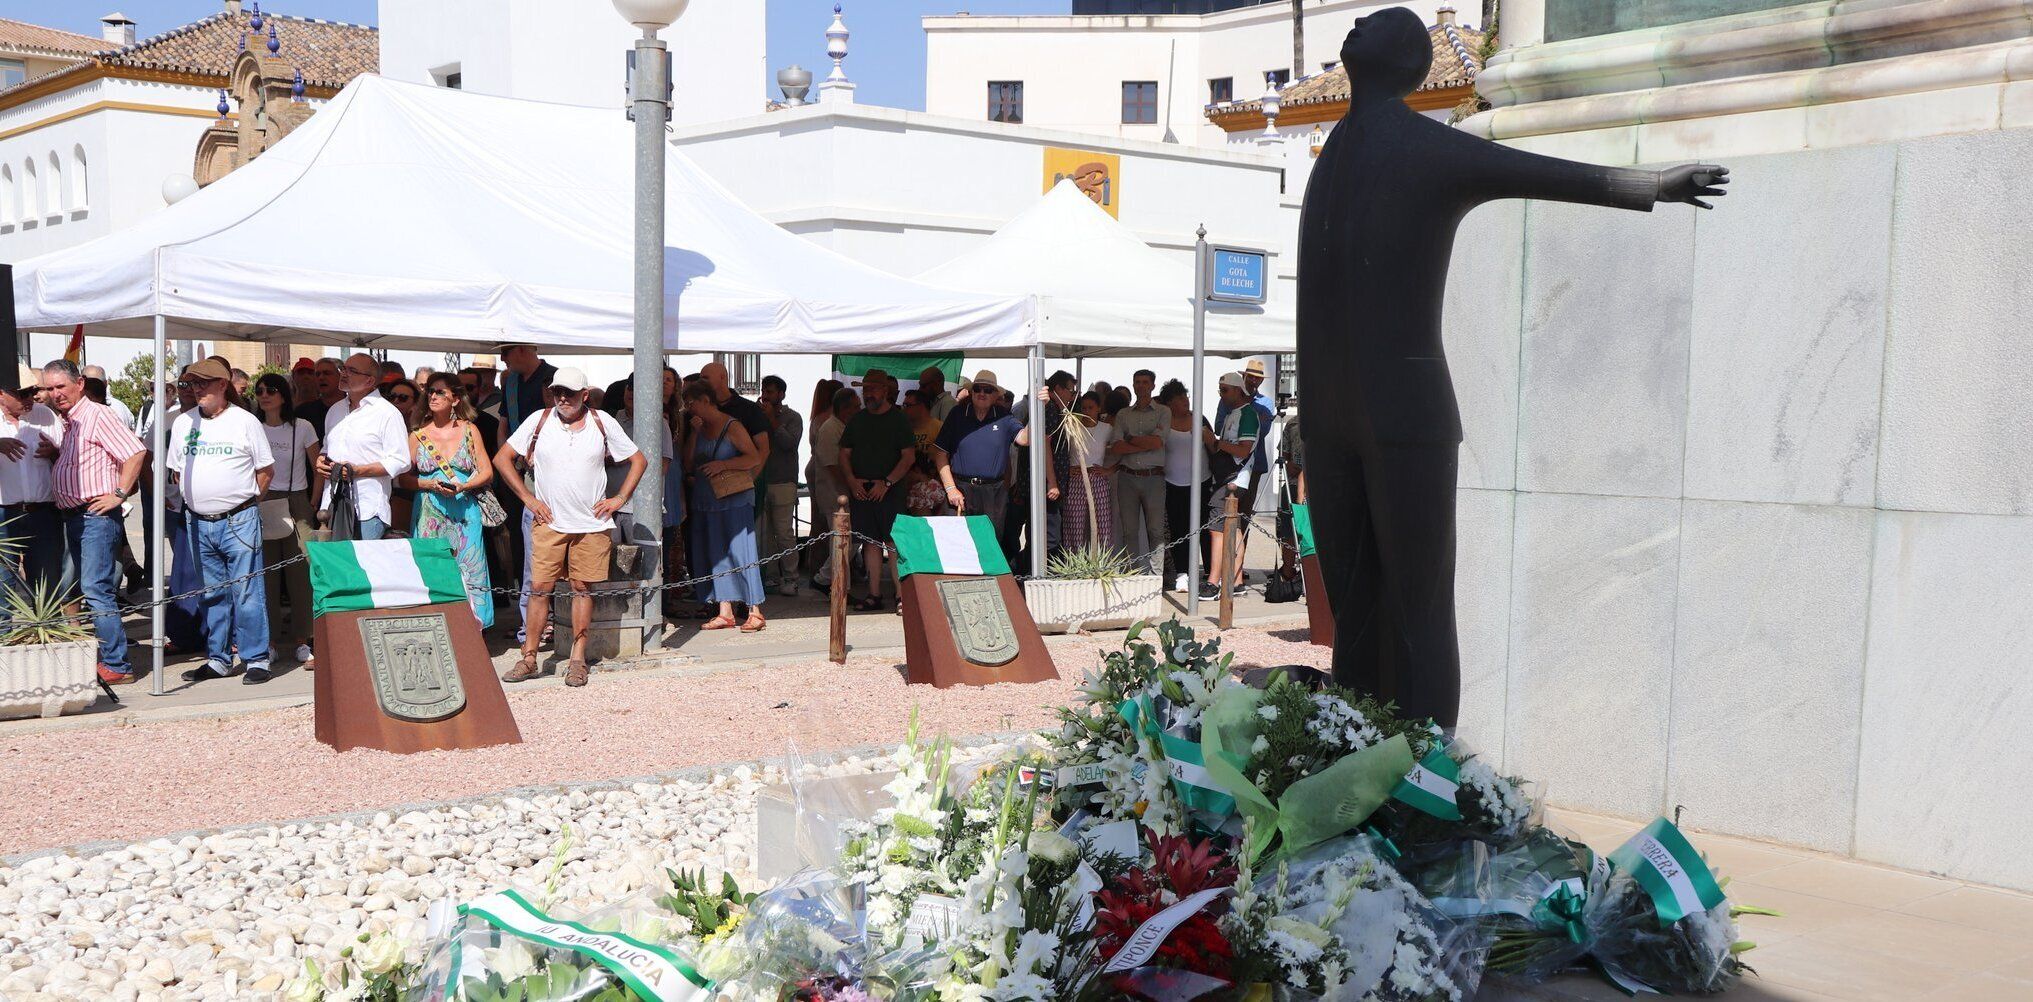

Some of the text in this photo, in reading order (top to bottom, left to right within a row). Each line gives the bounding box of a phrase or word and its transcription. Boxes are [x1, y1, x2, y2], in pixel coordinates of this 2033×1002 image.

[1228, 255, 1249, 264] CALLE
[1229, 267, 1248, 277] GOTA
[1221, 276, 1255, 288] DE LECHE
[368, 618, 432, 631] HERCULES
[433, 617, 456, 681] FUNDATOR
[535, 924, 664, 988] IU ANDALUCIA
